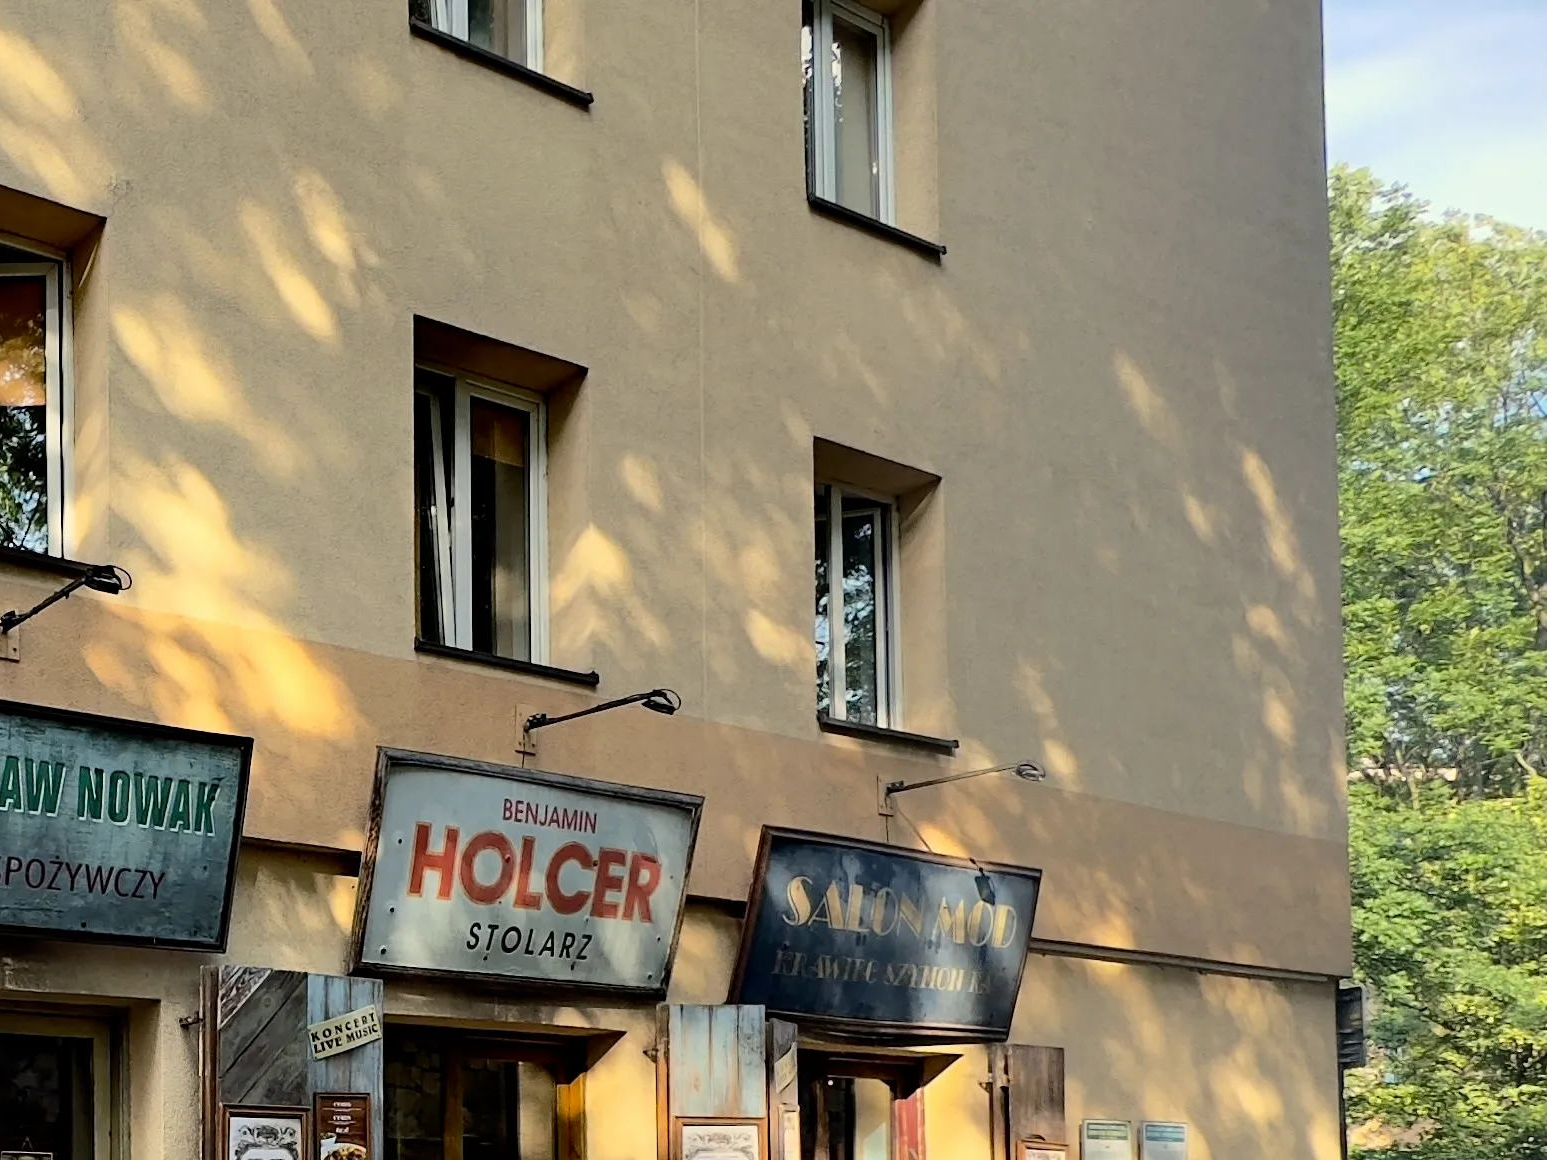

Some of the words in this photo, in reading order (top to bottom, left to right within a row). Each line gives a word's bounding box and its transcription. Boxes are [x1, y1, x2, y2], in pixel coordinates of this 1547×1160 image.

[77, 766, 221, 836] NOWAK
[502, 798, 598, 834] BENJAMIN
[407, 821, 662, 923] HOLCER
[782, 875, 925, 937] SALON
[932, 896, 1018, 948] MOD
[466, 922, 593, 960] STOLARZ
[311, 1012, 375, 1042] KONCERT
[314, 1036, 343, 1054] LIVE
[346, 1024, 378, 1044] MUSIC
